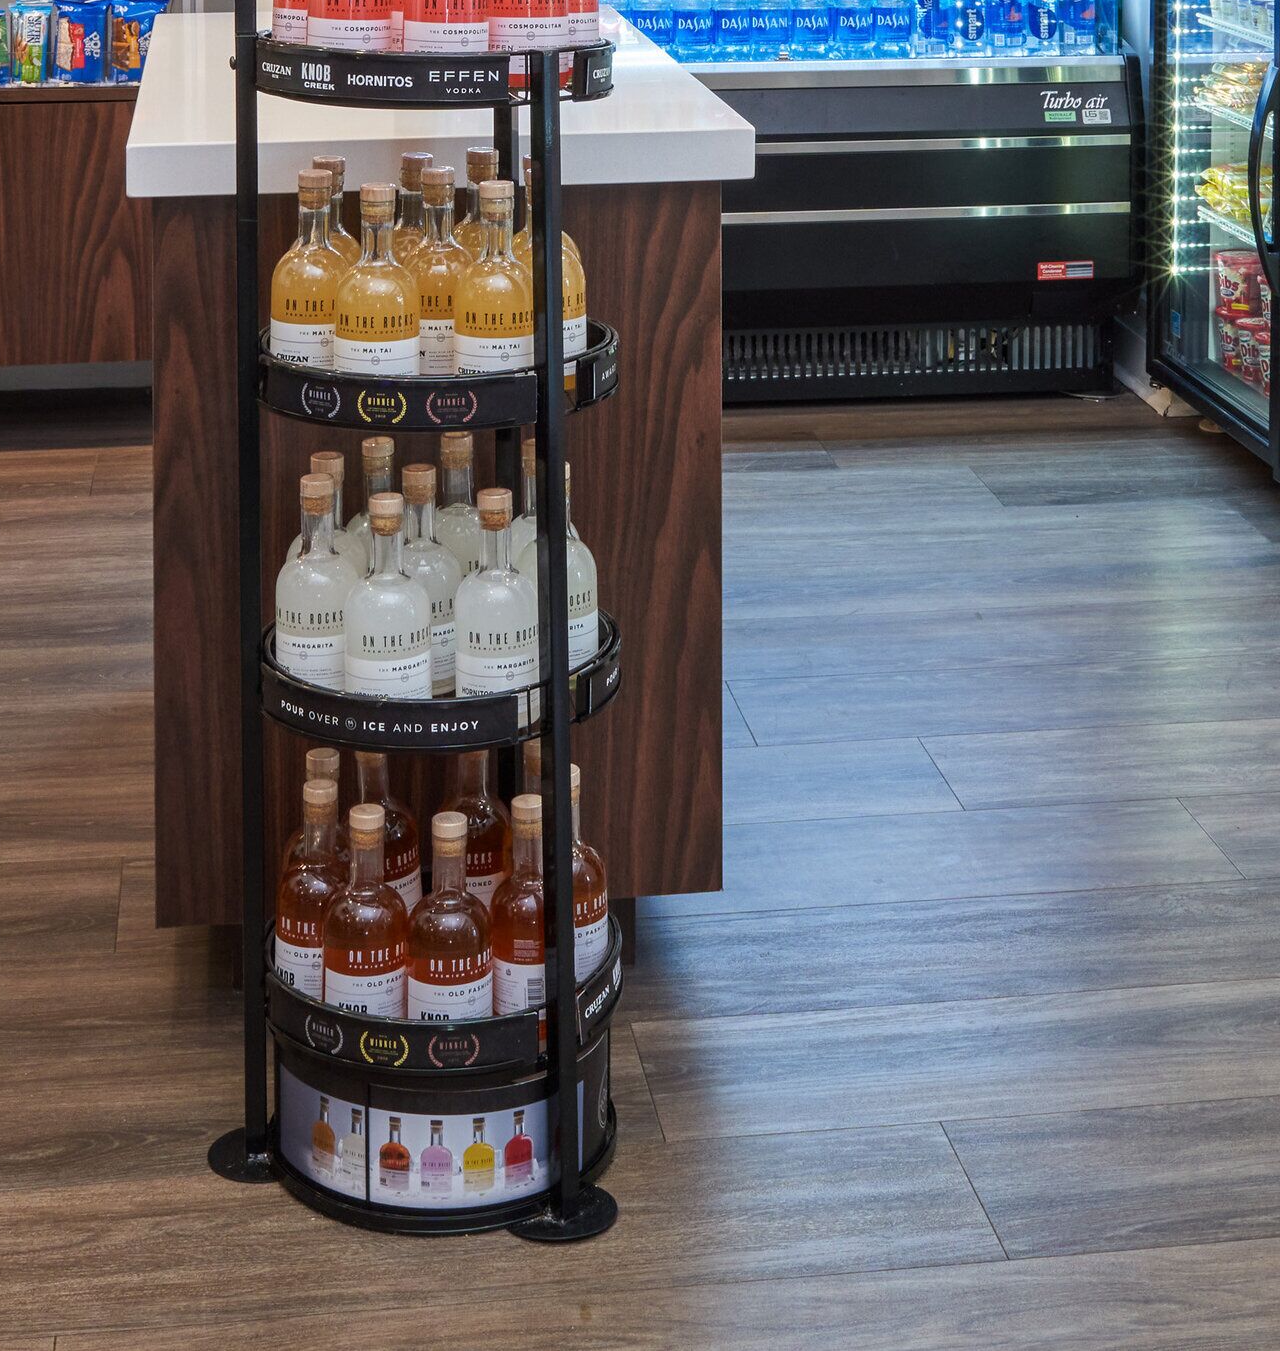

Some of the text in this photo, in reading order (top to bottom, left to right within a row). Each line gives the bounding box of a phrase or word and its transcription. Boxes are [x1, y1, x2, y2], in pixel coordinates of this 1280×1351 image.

[752, 13, 789, 32] DASANI
[967, 8, 979, 41] smart
[262, 62, 292, 76] CRUZAN
[301, 62, 331, 82] KNOB
[429, 70, 499, 82] EFFEN
[303, 82, 335, 91] CREEK
[347, 74, 413, 89] HORNITOS
[1040, 91, 1108, 109] Turbo air
[356, 315, 378, 328] THE
[309, 610, 344, 624] ROCKS
[292, 641, 334, 649] MARGARITA
[382, 634, 403, 647] THE
[281, 700, 479, 733] POUR OVER ICE AND ENJOY
[349, 948, 389, 963] ON THE
